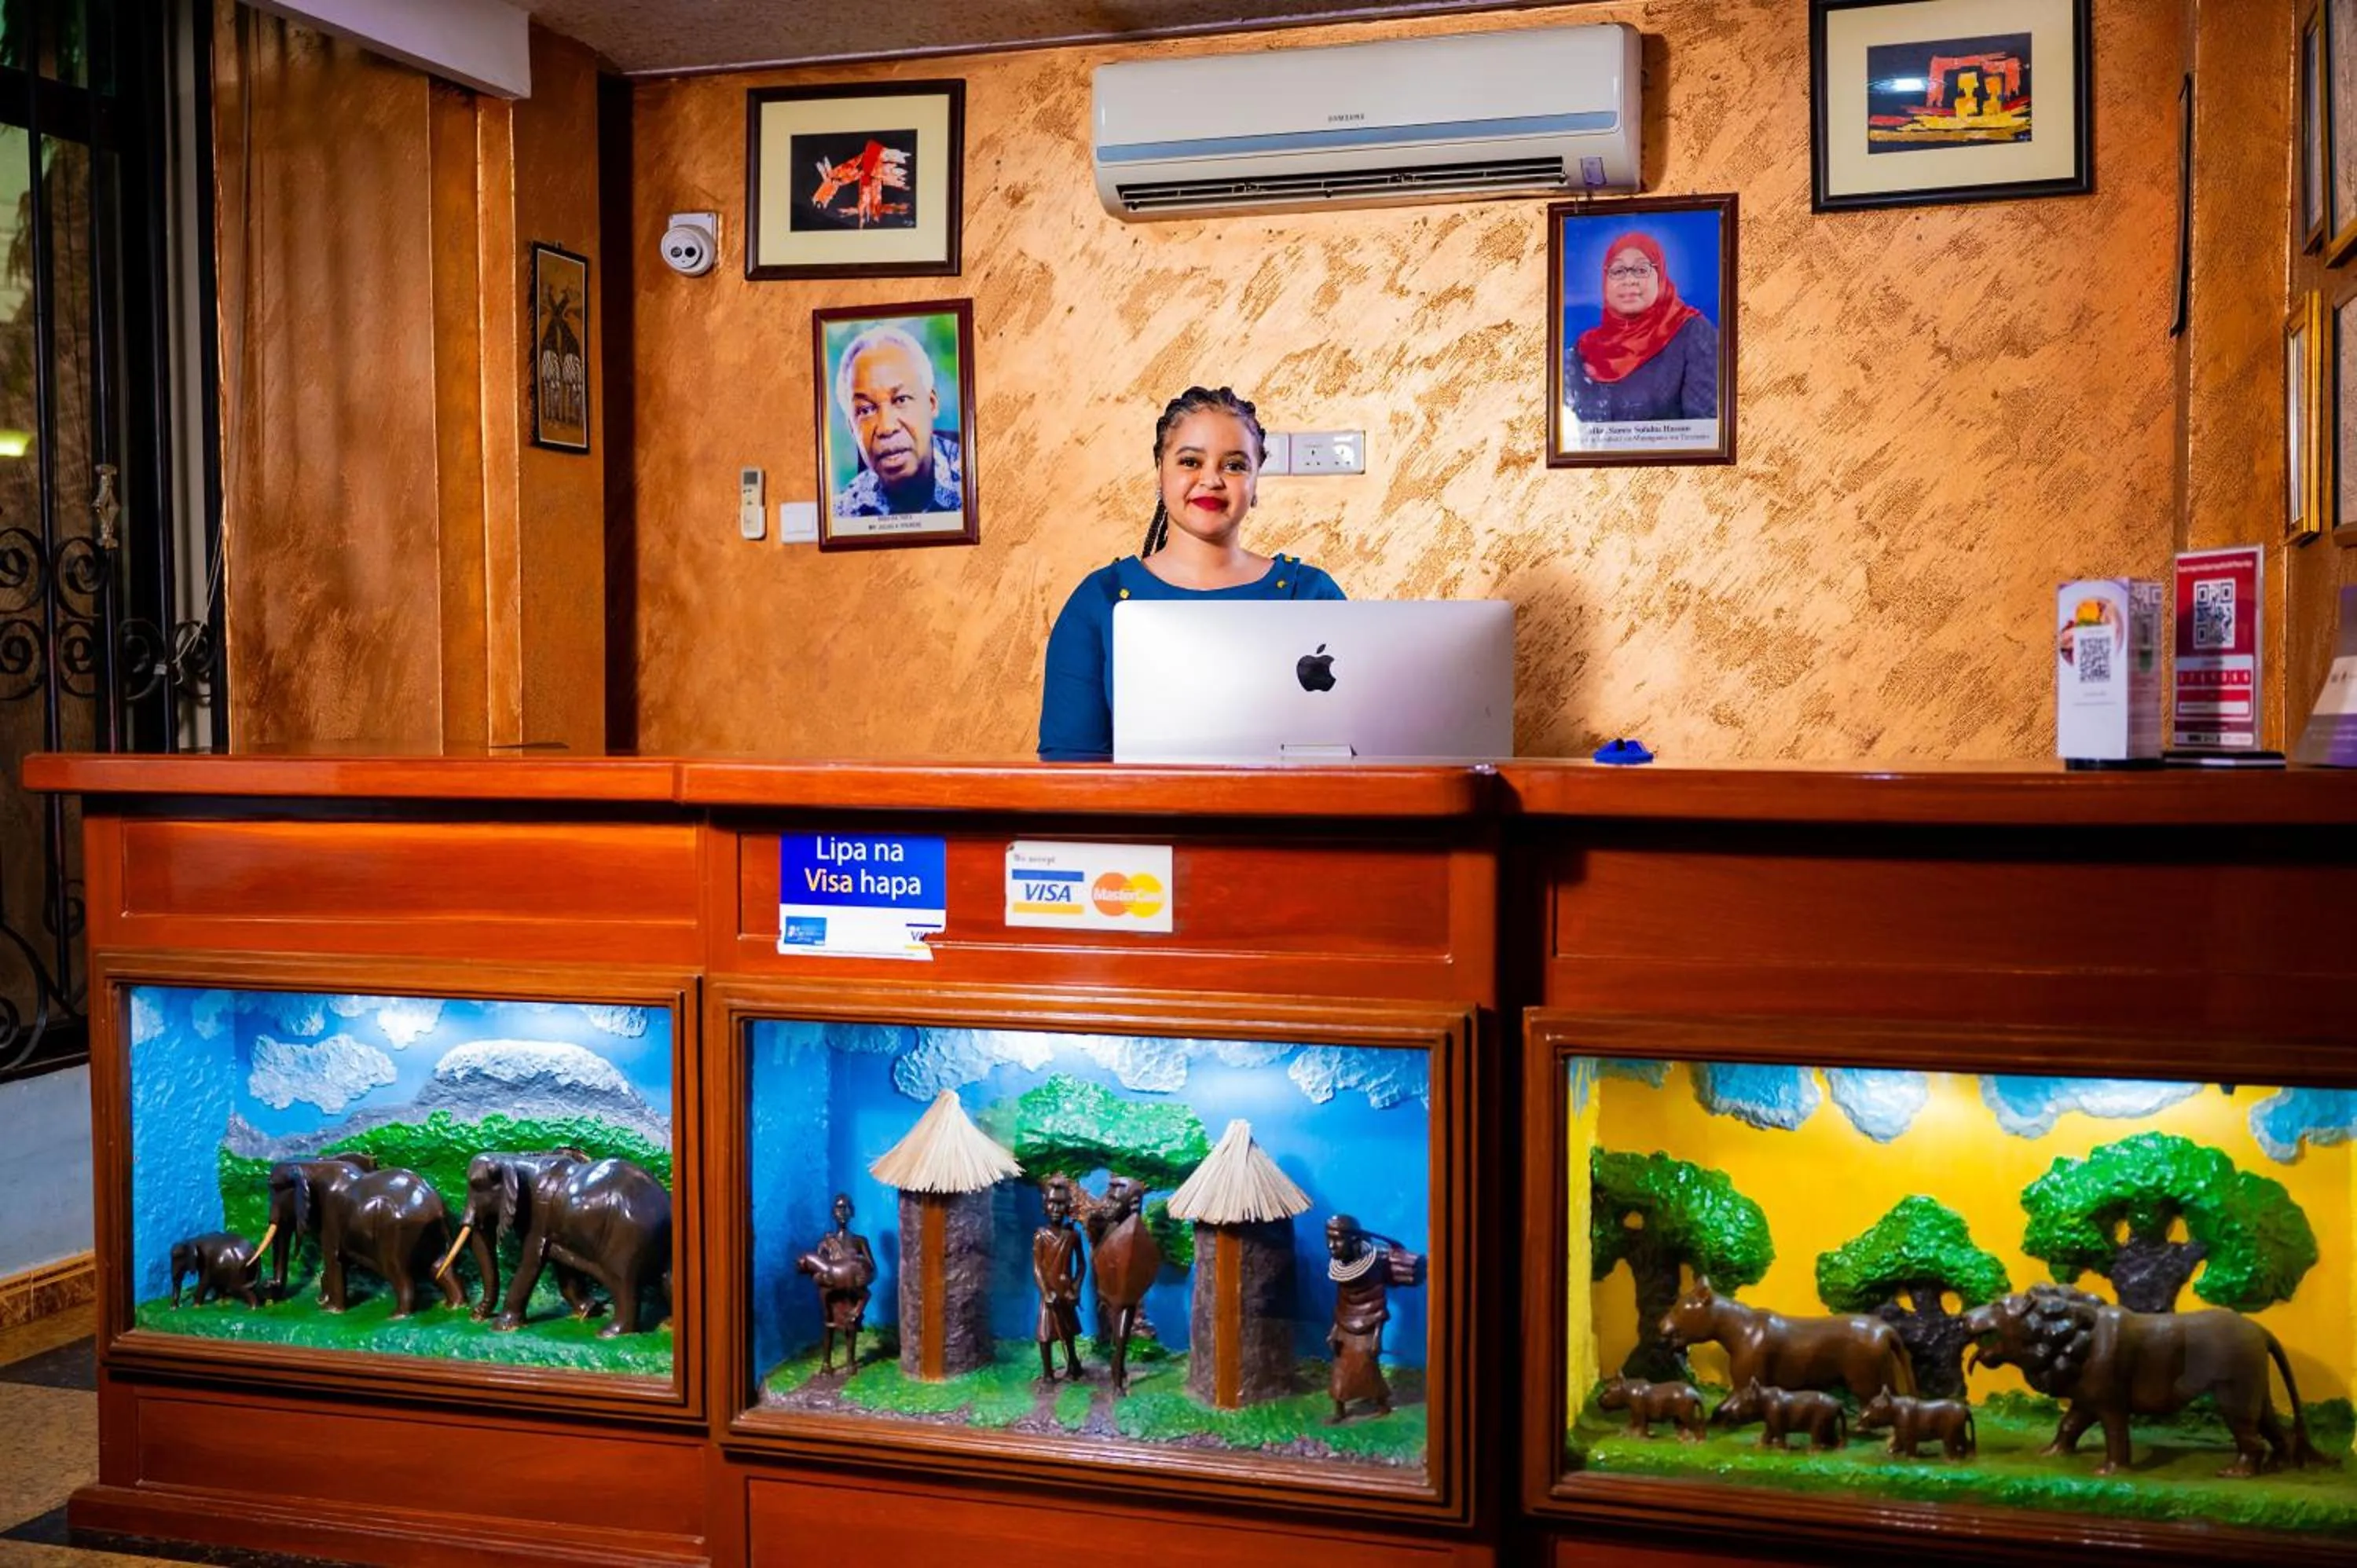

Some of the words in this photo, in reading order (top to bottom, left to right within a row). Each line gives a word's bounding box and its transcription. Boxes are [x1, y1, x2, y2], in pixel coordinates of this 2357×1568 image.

[816, 835, 867, 866] Lipa
[874, 843, 904, 862] na
[804, 866, 852, 892] Visa
[860, 868, 922, 901] hapa
[1024, 882, 1072, 903] VISA
